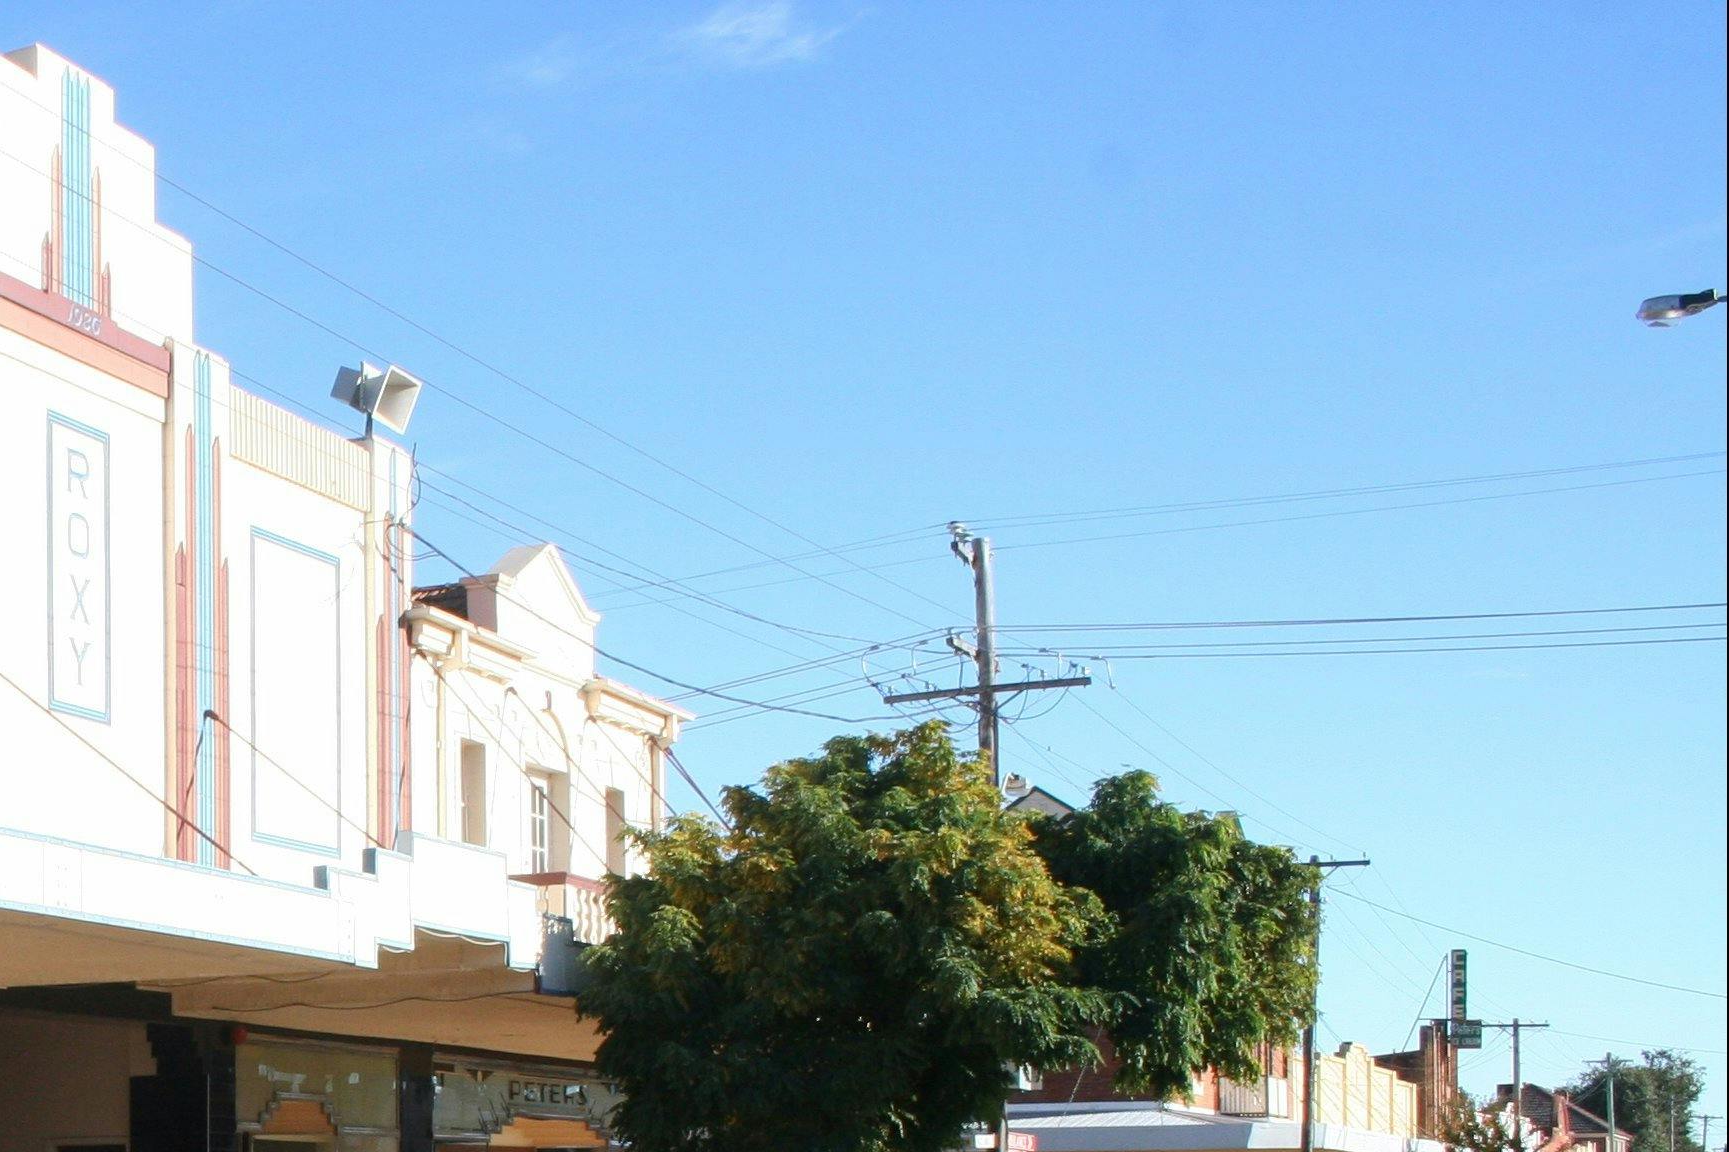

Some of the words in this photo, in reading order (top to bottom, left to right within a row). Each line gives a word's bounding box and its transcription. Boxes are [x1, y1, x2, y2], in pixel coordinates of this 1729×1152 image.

[67, 447, 90, 686] ROXY
[1452, 952, 1464, 1021] CAFE
[508, 1079, 588, 1105] PETERS
